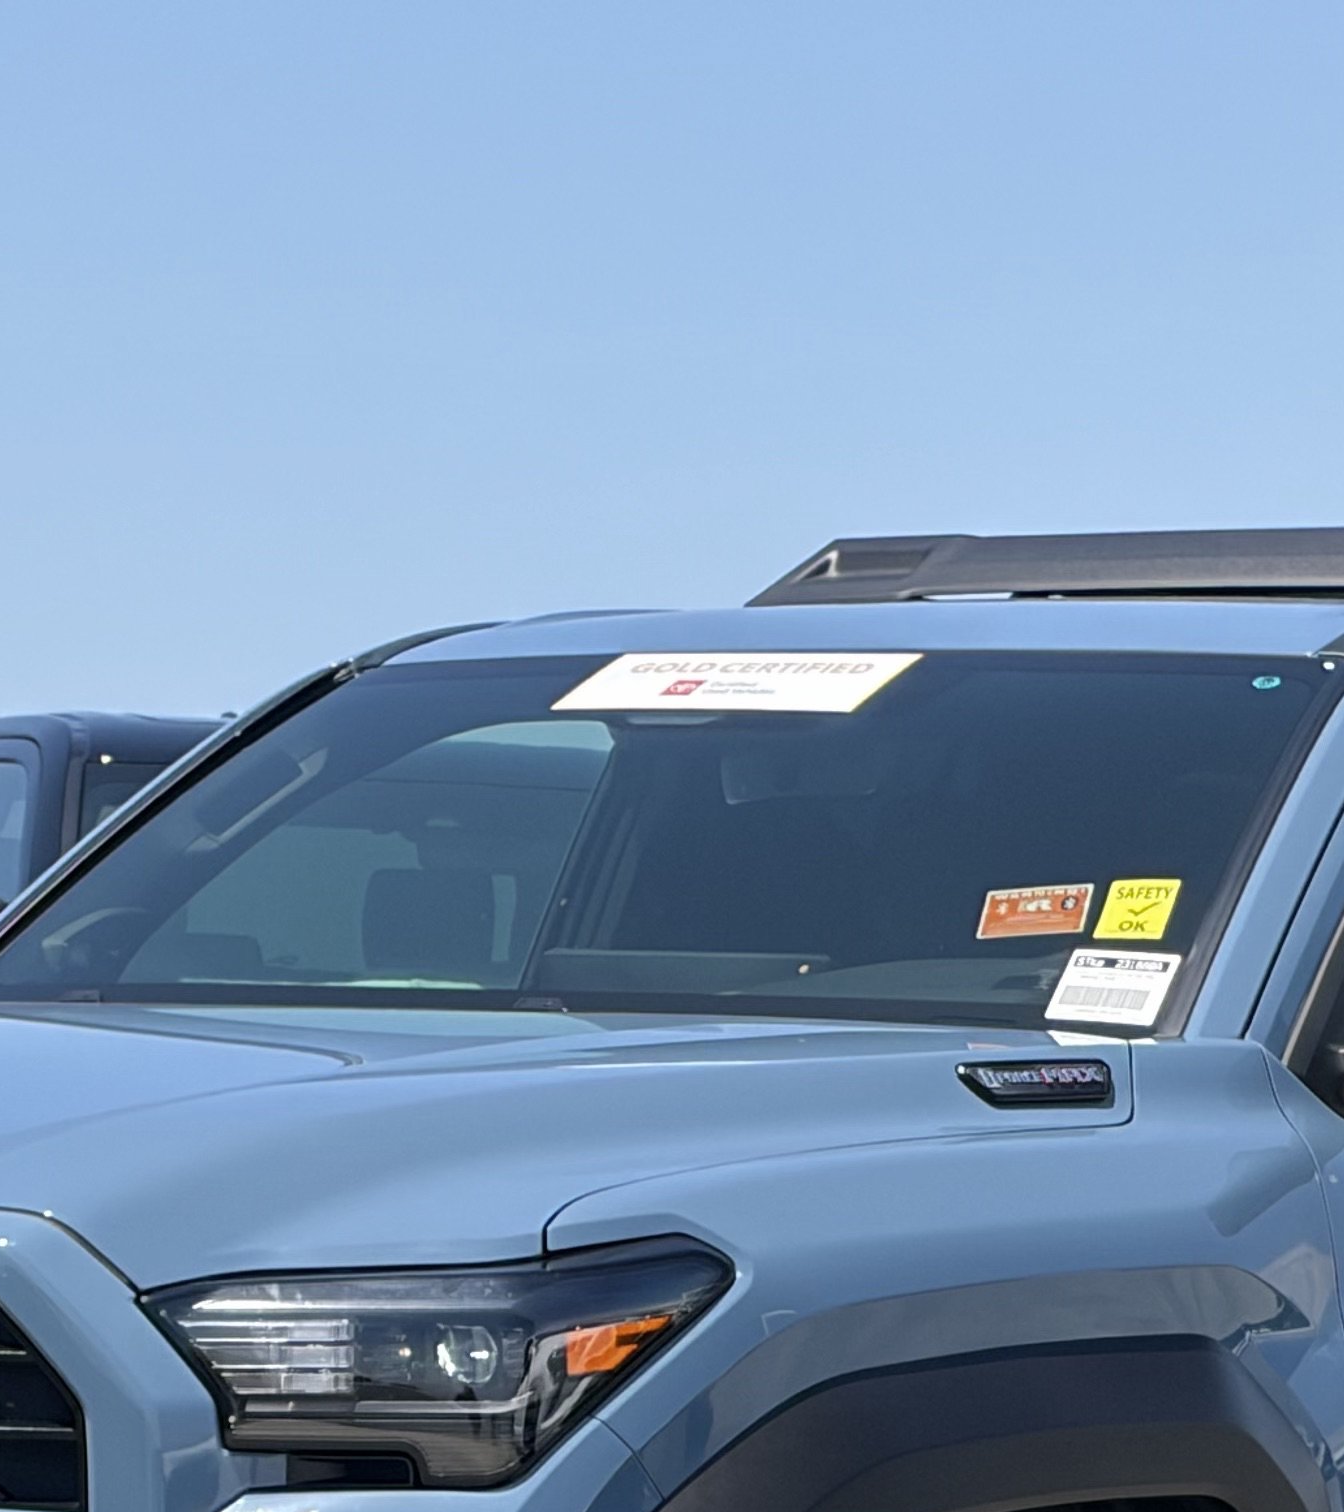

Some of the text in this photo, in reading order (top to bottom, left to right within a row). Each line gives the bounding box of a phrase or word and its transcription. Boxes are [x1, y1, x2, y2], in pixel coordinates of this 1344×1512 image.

[630, 662, 876, 675] GOLD CERTIFIED
[1116, 886, 1174, 900] SAFETY
[1118, 920, 1149, 933] OK
